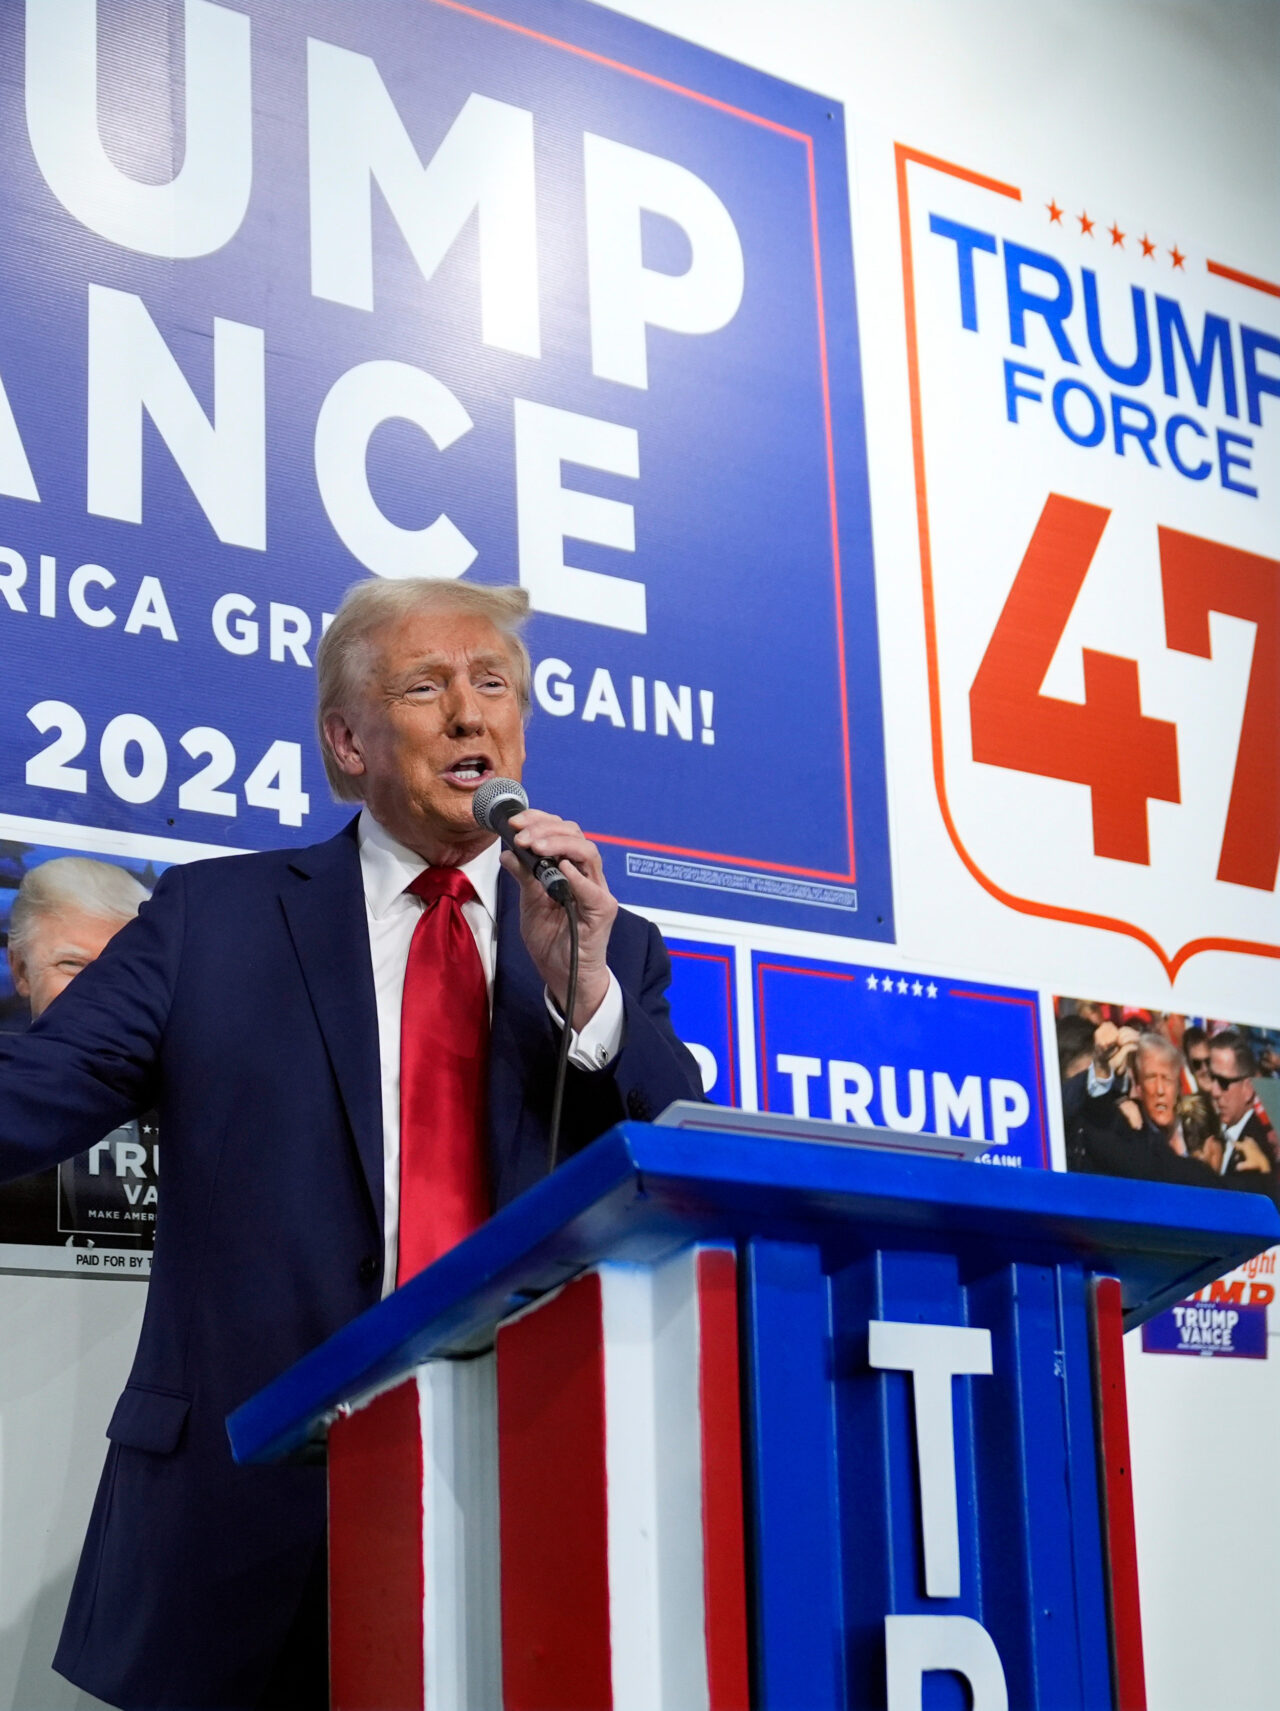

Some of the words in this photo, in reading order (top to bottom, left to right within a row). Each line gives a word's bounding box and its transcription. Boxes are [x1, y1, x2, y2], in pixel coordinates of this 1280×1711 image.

[1003, 357, 1259, 499] FORCE
[533, 657, 715, 745] GAIN!
[969, 491, 1280, 892] 47
[25, 700, 310, 827] 2024
[777, 1053, 1030, 1145] TRUMP
[88, 1209, 120, 1219] MAKE
[124, 1211, 157, 1221] AMER
[76, 1254, 100, 1266] PAID
[103, 1256, 126, 1267] FOR
[130, 1257, 143, 1268] BY
[1172, 1306, 1239, 1330] TRUMP
[1181, 1326, 1232, 1346] VANCE
